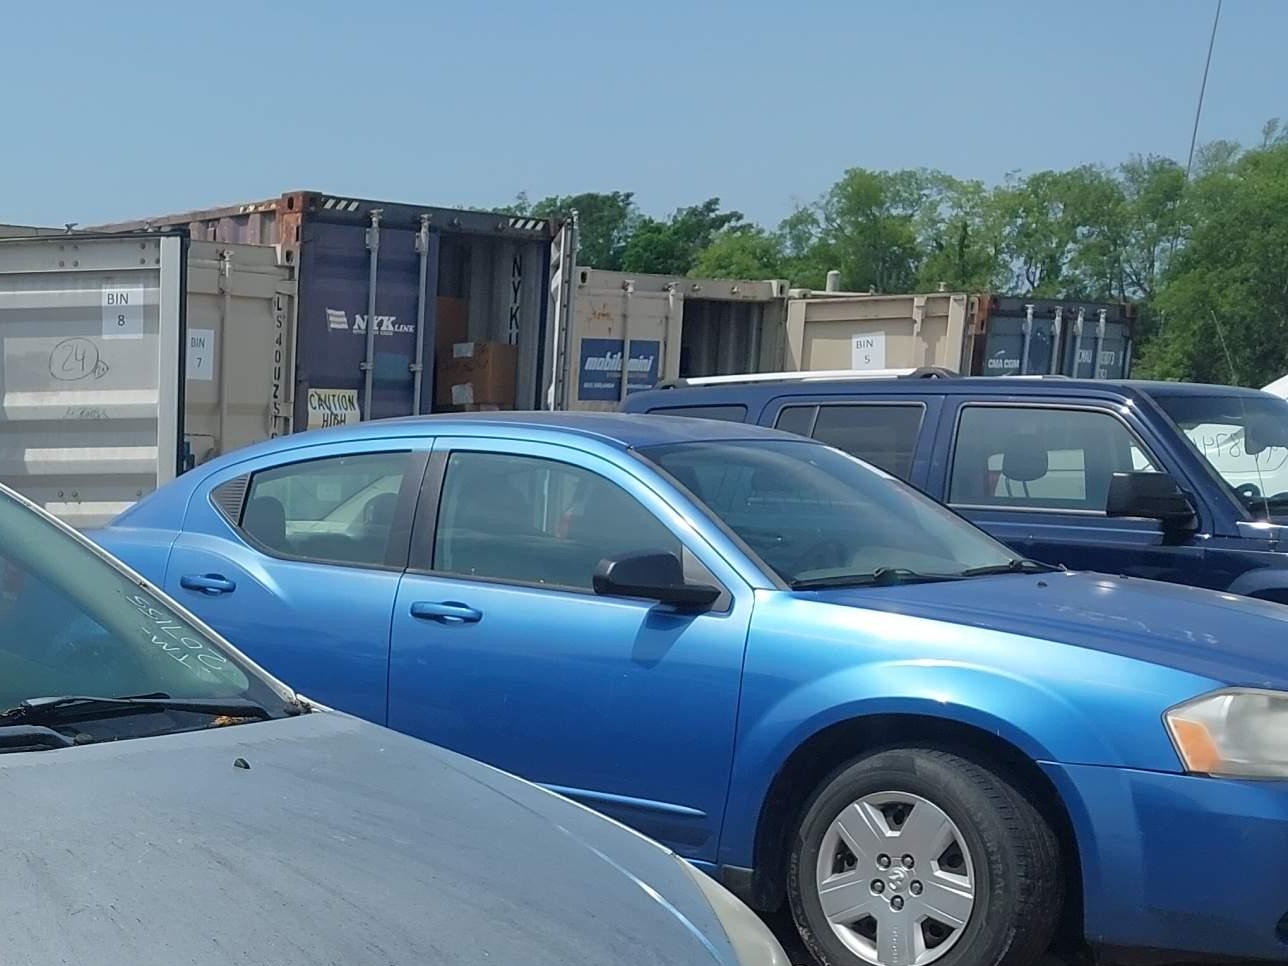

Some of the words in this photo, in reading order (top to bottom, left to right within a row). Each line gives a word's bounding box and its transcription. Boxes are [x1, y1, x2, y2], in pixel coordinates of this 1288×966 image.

[107, 293, 129, 305] BIN
[117, 314, 126, 326] 8
[395, 324, 416, 333] LINE
[190, 337, 205, 348] BIN
[856, 339, 873, 349] BIN
[62, 344, 86, 374] 24
[196, 357, 202, 368] 7
[864, 354, 871, 364] 5
[309, 392, 357, 411] CAUTION
